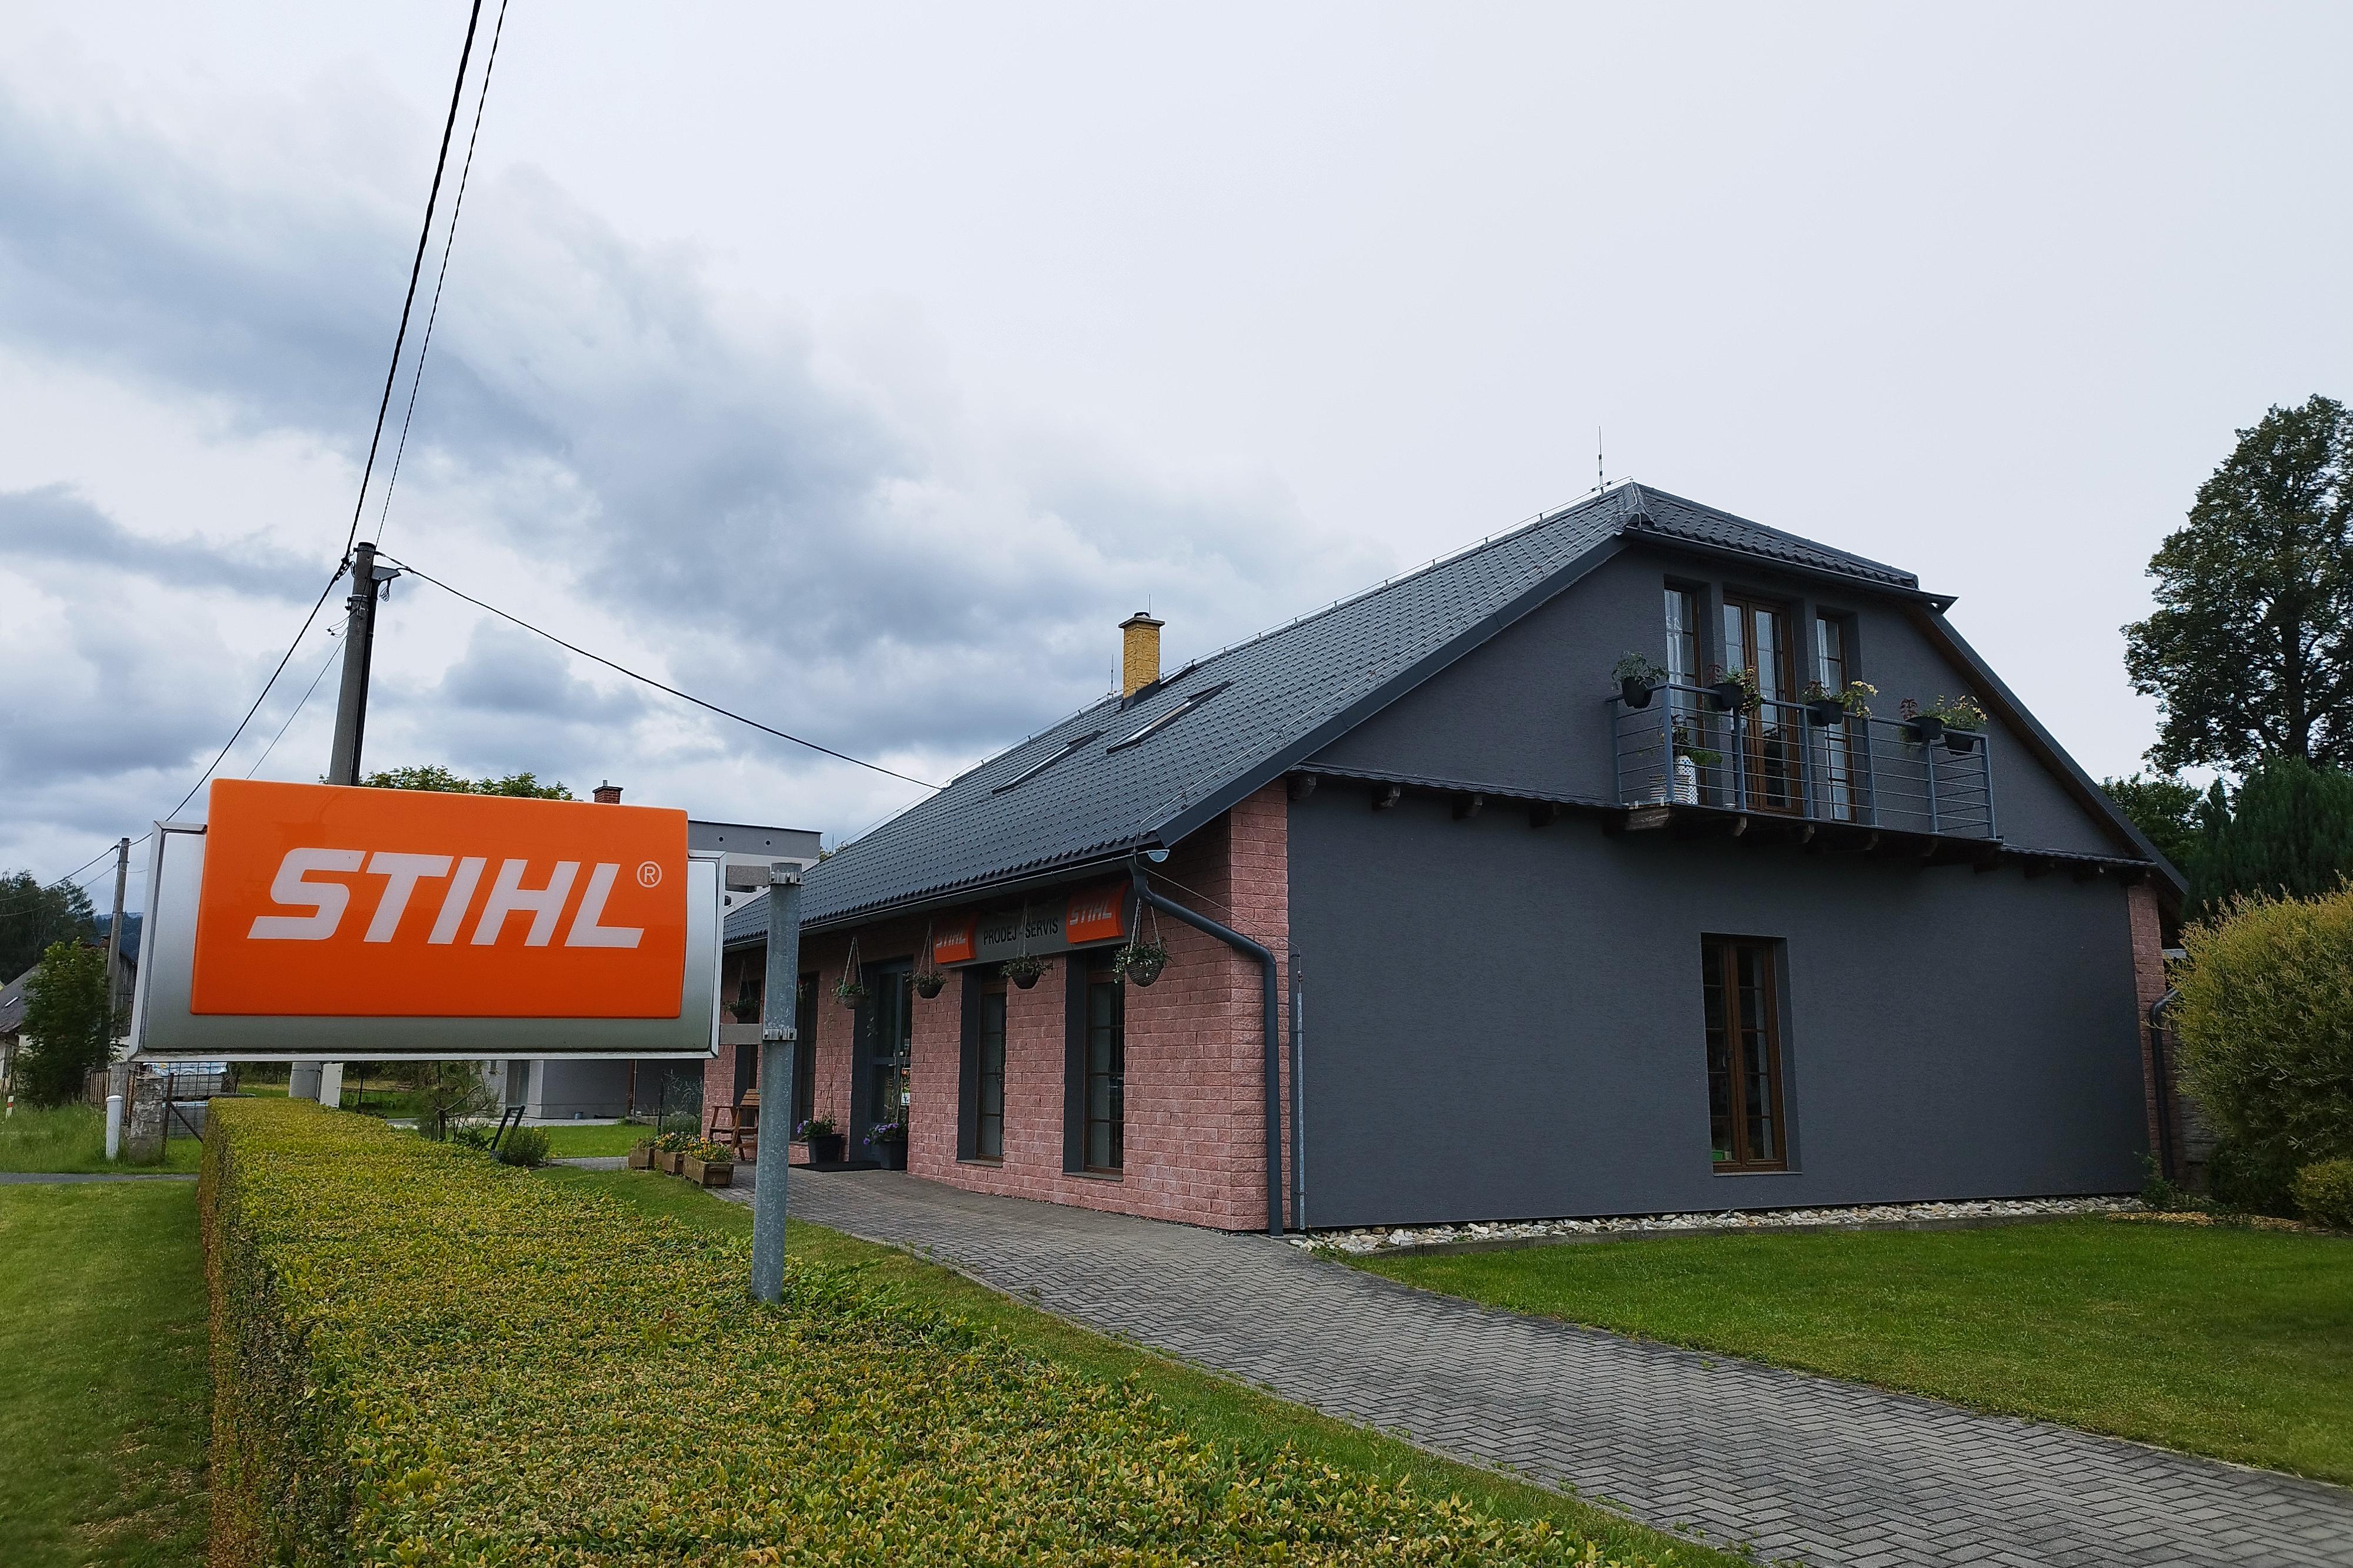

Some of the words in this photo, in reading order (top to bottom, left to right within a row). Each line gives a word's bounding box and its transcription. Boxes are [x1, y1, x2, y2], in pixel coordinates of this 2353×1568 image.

[247, 847, 645, 948] STIHL
[1069, 898, 1112, 925] STIHL
[983, 925, 1017, 945] PRODEJ
[1025, 918, 1059, 938] SERVIS
